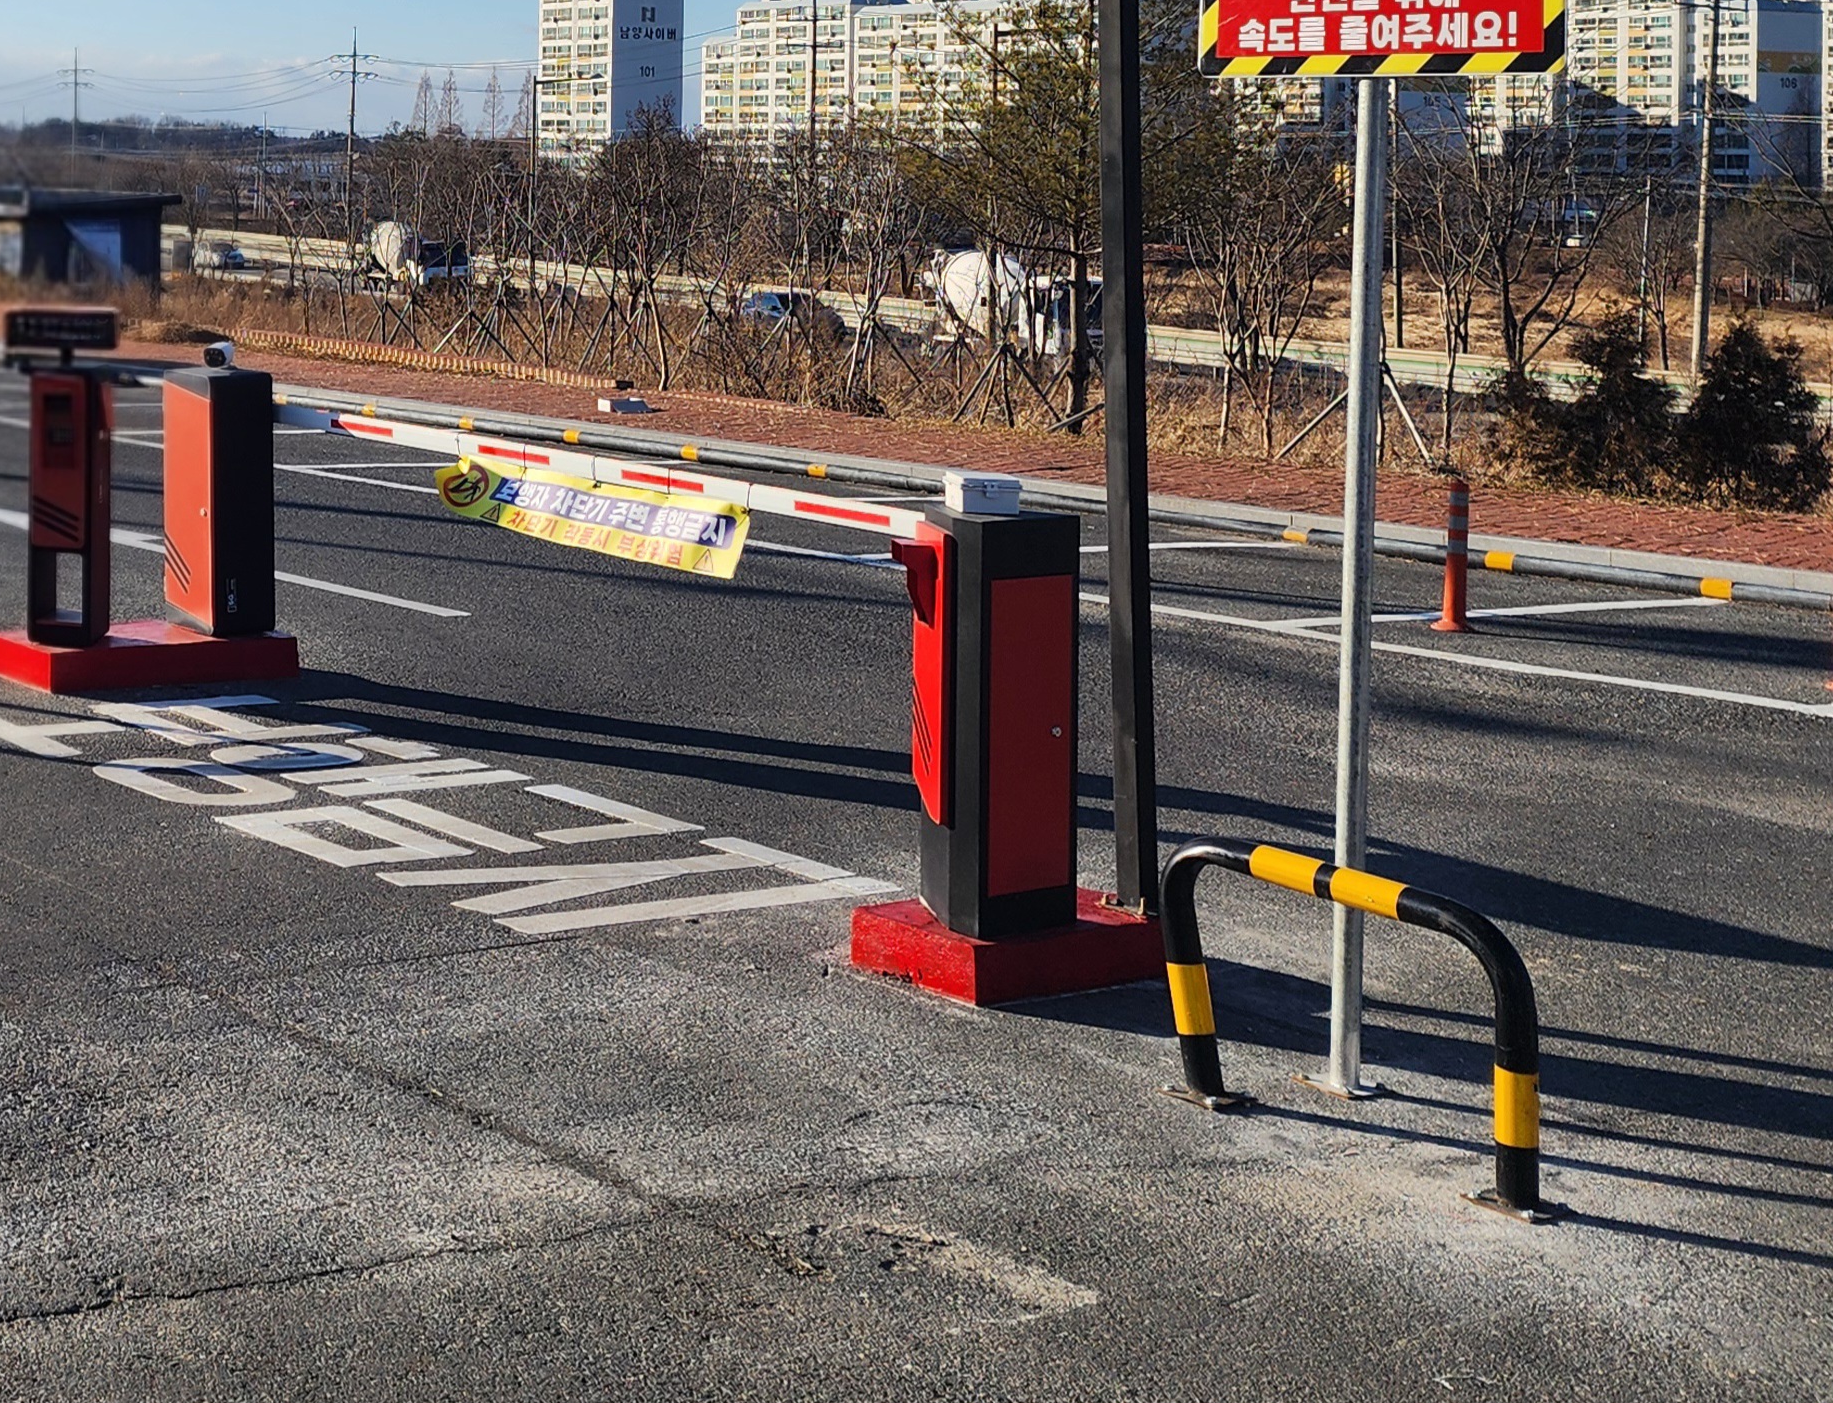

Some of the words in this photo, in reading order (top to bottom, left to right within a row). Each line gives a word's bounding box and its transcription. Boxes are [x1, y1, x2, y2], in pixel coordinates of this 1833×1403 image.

[619, 26, 677, 41] 남양사이버
[1238, 15, 1326, 52] 속도를
[1339, 10, 1518, 50] 줄여주세요!
[639, 65, 655, 78] 101
[495, 479, 551, 508] 보행자
[550, 488, 611, 523] 차단기
[608, 501, 650, 532] 주변
[650, 507, 727, 547] 통행금지
[506, 510, 559, 539] 차단기
[617, 534, 684, 566] 부상위험
